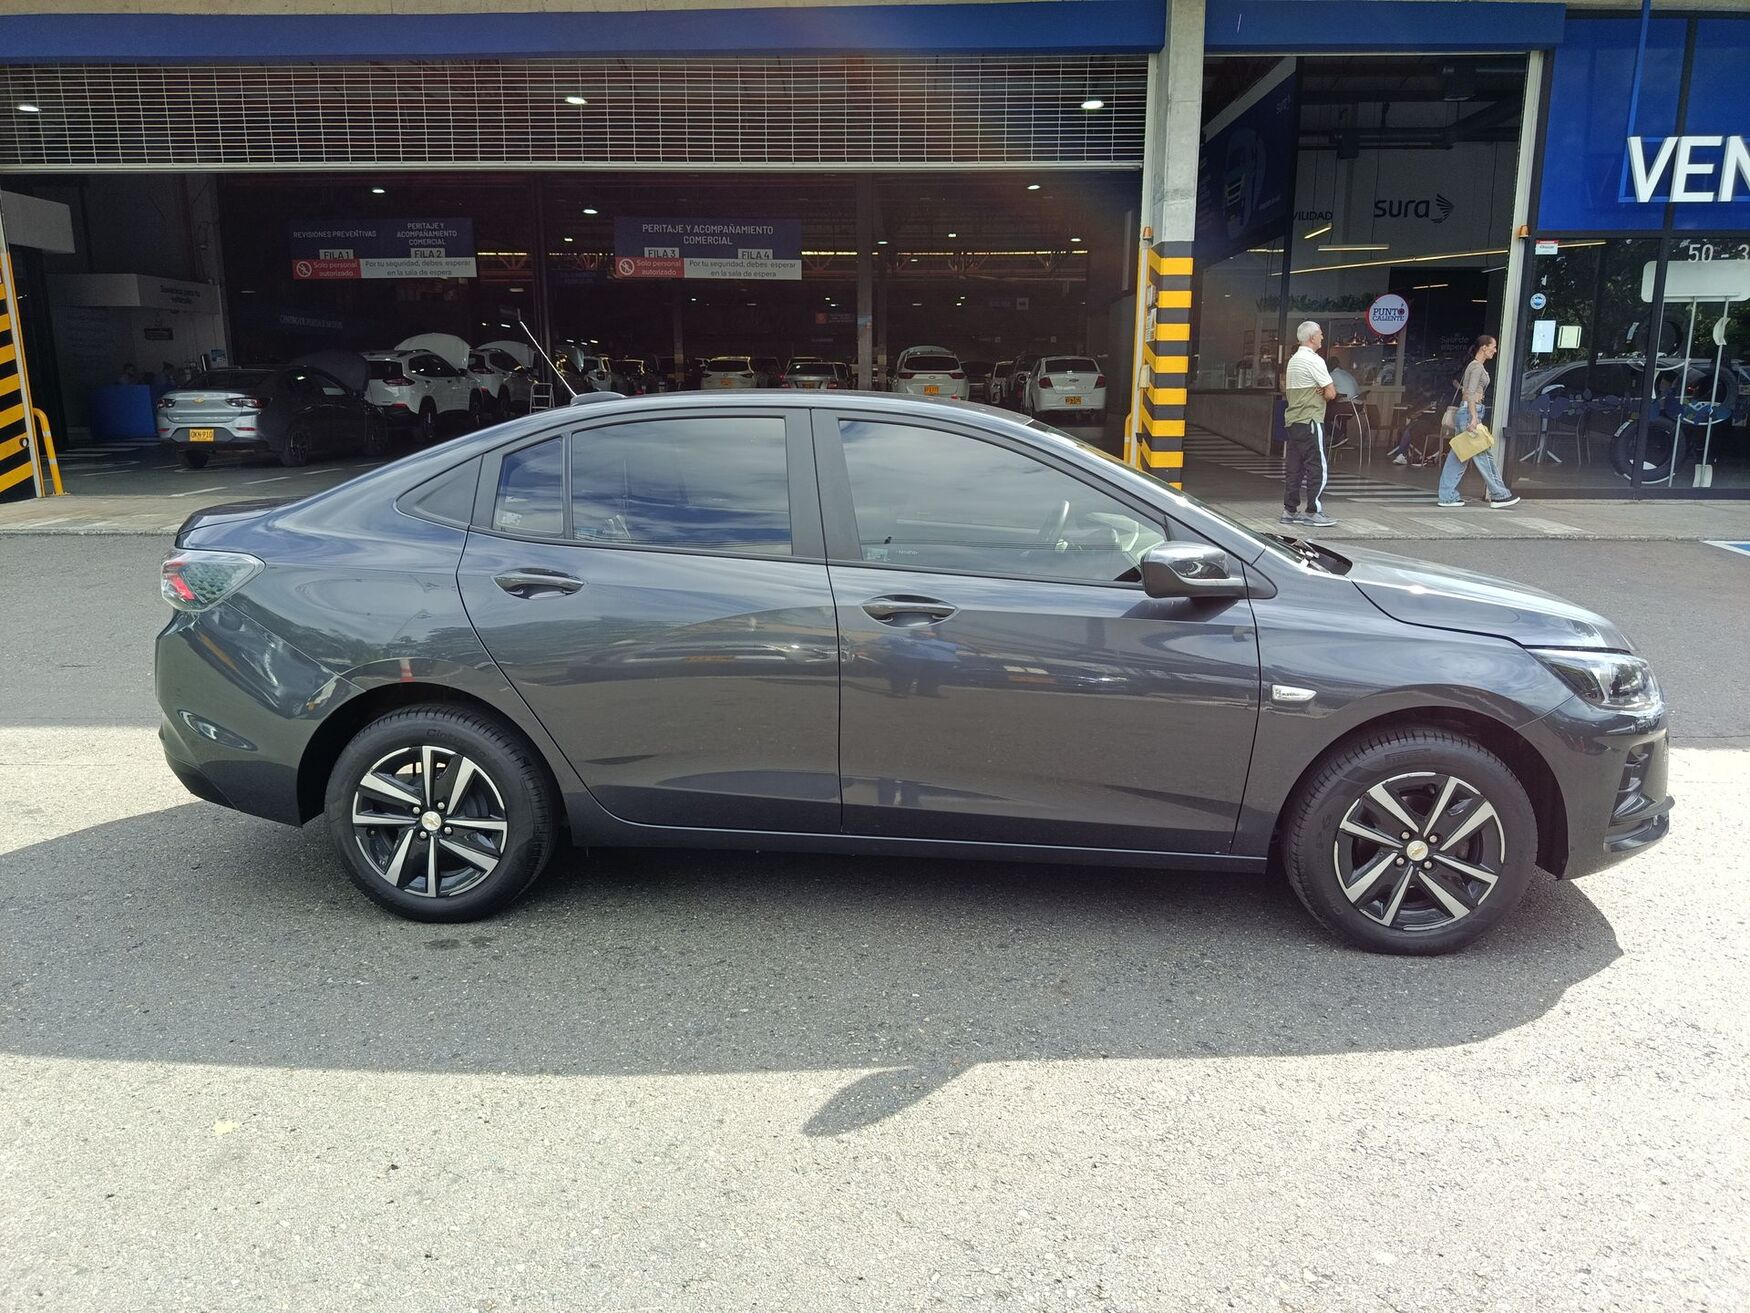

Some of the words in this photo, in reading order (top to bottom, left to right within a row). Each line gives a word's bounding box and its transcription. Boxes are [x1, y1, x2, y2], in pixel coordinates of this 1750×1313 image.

[1374, 200, 1430, 219] sura
[292, 231, 332, 239] REVISIONES
[333, 229, 377, 238] PREVENTIVAS
[397, 229, 458, 238] ACOMPAÑAMIENTO
[642, 224, 684, 233] PERITAJE
[686, 225, 692, 233] Y
[693, 224, 774, 235] ACOMPAÑAMIENTO
[683, 236, 733, 245] COMERCIAL
[324, 251, 344, 259] FILA
[414, 250, 434, 258] FILA
[436, 250, 442, 258] 2
[648, 249, 668, 258] FILA
[670, 249, 676, 258] 3
[742, 251, 761, 259] FILA
[764, 251, 770, 259] 4
[1687, 244, 1714, 263] 50
[653, 260, 681, 268] personal
